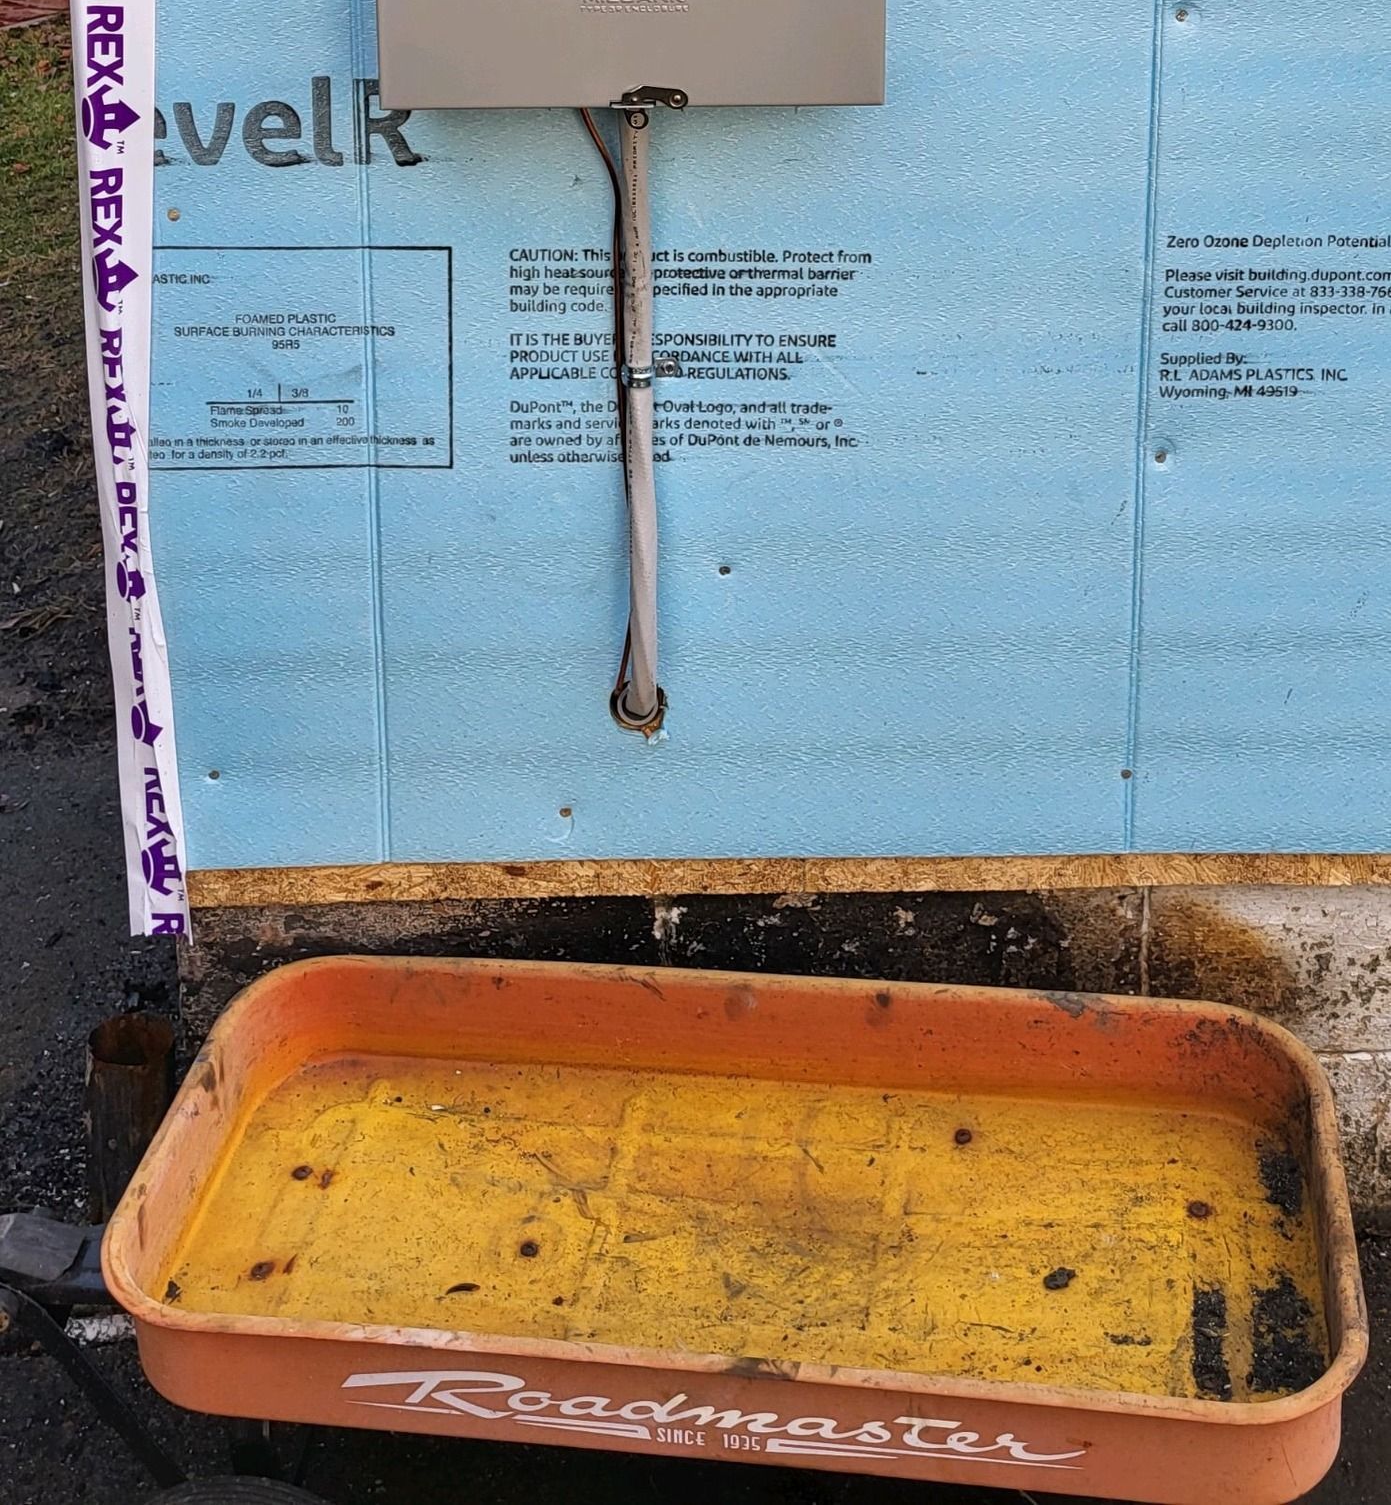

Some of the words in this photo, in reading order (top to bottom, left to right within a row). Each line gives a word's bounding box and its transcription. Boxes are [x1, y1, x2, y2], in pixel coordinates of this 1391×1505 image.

[1167, 235, 1199, 248] Zero
[1204, 235, 1248, 248] Ozone
[1253, 234, 1322, 250] Depletion
[509, 249, 578, 262] CAUTION:
[584, 249, 611, 262] This
[688, 250, 778, 263] combustible.
[783, 251, 834, 264] Protect
[838, 251, 872, 263] from
[545, 267, 576, 278] heat
[654, 268, 725, 282] protective
[749, 268, 804, 280] thermal
[808, 269, 856, 281] barrier
[1165, 269, 1211, 282] Please
[1216, 268, 1244, 281] visit
[510, 286, 539, 299] may
[543, 284, 560, 296] be
[730, 285, 753, 296] the
[756, 285, 838, 300] appropriate
[1235, 286, 1288, 298] Service
[510, 301, 567, 315] building
[571, 301, 608, 312] code.
[1237, 303, 1295, 317] building
[1300, 303, 1367, 318] inspector.
[236, 314, 285, 324] FOAMED
[287, 314, 336, 324] PLASTIC
[1162, 320, 1187, 332] call
[1192, 319, 1297, 332] 800-424-9300.
[174, 327, 229, 337] SURFACE
[232, 327, 286, 337] BURNING
[288, 326, 395, 337] CHARACTERISTICS
[272, 340, 300, 350] 95R5
[756, 335, 774, 347] TO
[779, 335, 836, 347] ENSURE
[510, 351, 578, 363] PRODUCT
[584, 351, 609, 363] USE
[1160, 353, 1222, 367] Supplied
[510, 368, 596, 380] APPLICABLE
[687, 368, 791, 381] REGULATIONS.
[1189, 369, 1242, 382] ADAMS
[1246, 368, 1315, 382] PLASTICS
[1321, 368, 1348, 382] INC
[1159, 386, 1229, 400] Wyoming,
[1256, 386, 1298, 398] 49519
[700, 401, 737, 416] Logo,
[210, 418, 247, 429] Smoke
[249, 418, 304, 430] Developed
[336, 417, 355, 428] 200
[510, 418, 552, 430] marks
[684, 418, 742, 431] denoted
[746, 418, 776, 431] with
[688, 434, 740, 447] DuPont
[765, 435, 830, 448] Nemours,
[510, 452, 552, 462] unless
[342, 1368, 1087, 1462] Roadmaster
[657, 1428, 707, 1447] SINCE
[723, 1433, 761, 1453] 1935
